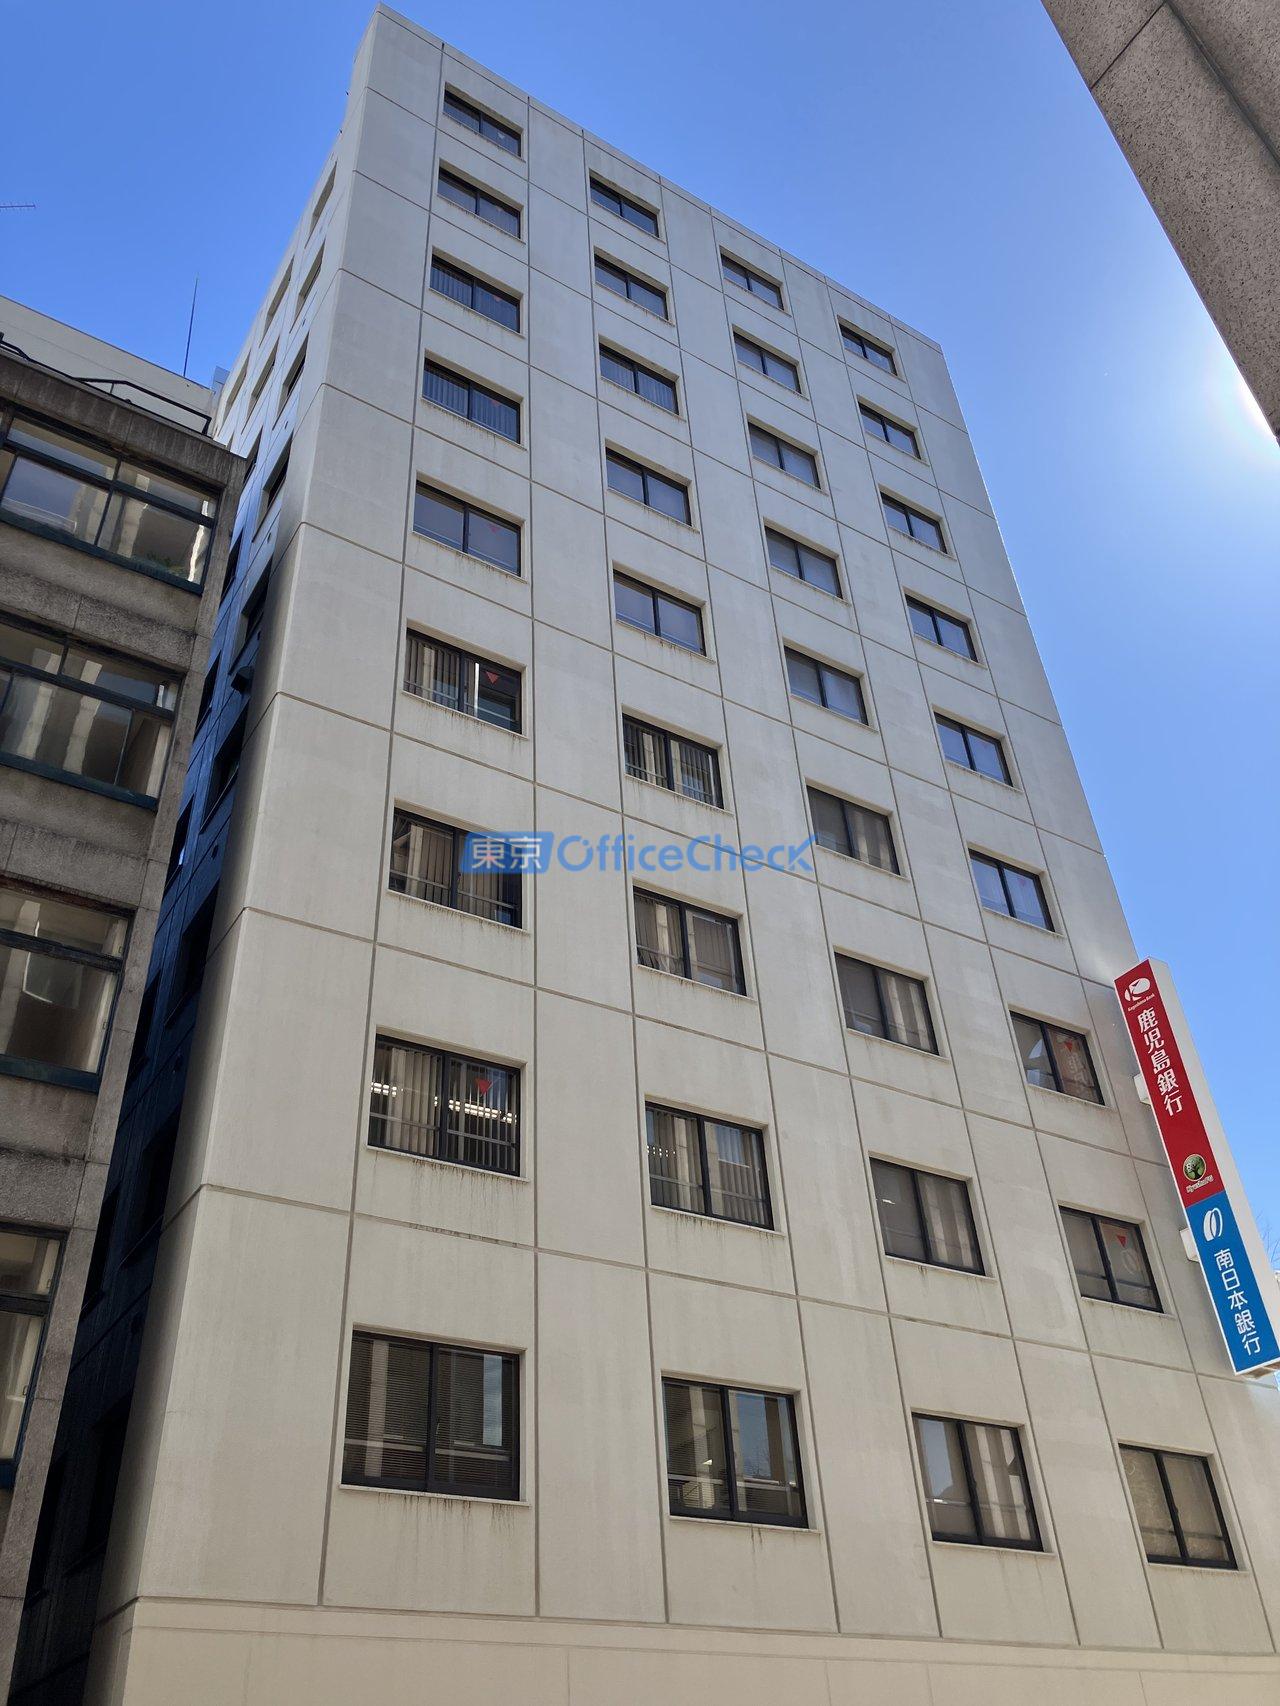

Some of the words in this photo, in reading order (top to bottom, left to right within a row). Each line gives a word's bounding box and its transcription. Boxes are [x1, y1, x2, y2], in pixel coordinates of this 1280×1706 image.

[1137, 1006, 1183, 1117] 鹿児島銀行
[1213, 1247, 1262, 1356] 南日本銀行
